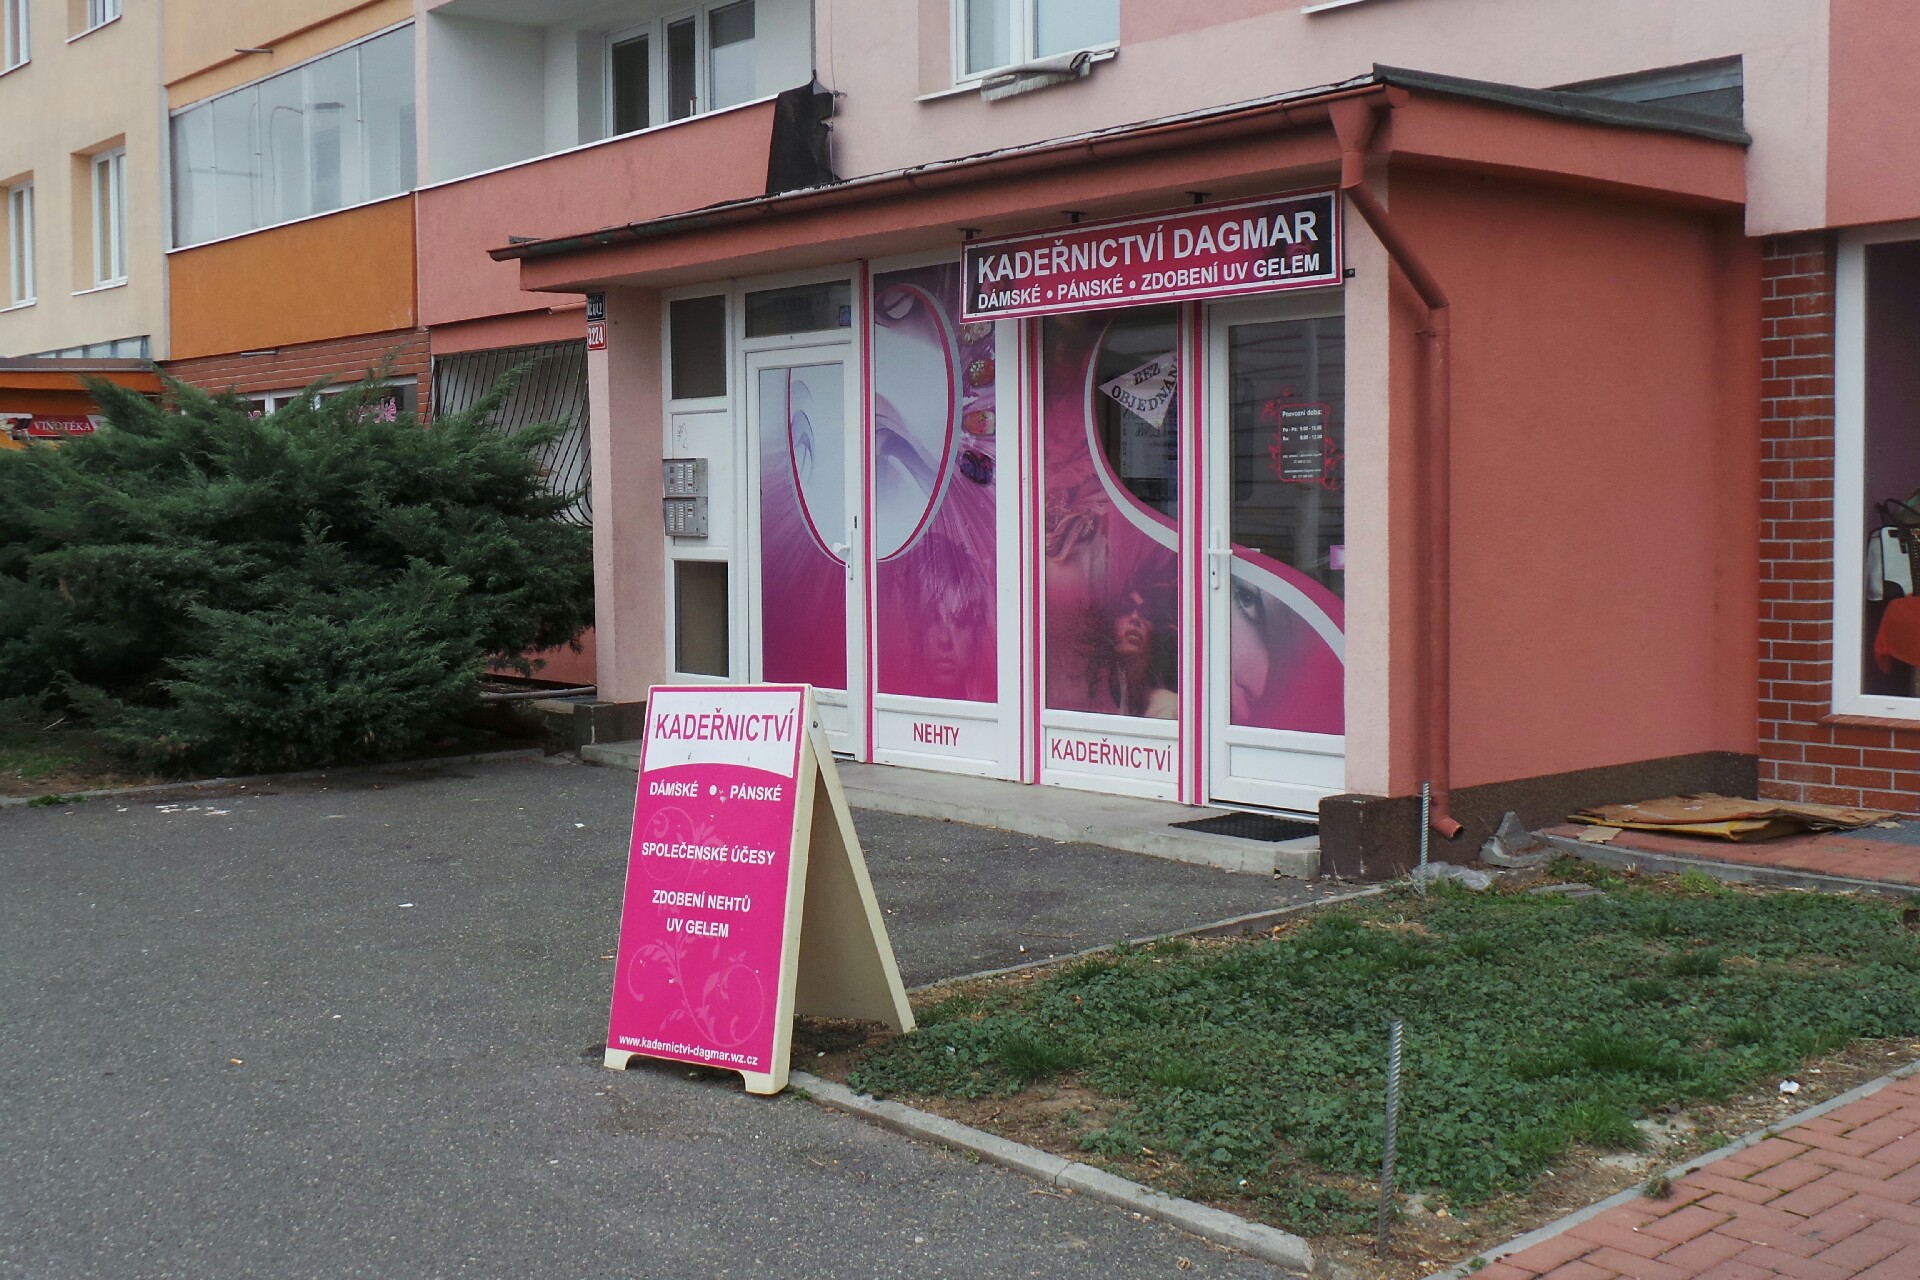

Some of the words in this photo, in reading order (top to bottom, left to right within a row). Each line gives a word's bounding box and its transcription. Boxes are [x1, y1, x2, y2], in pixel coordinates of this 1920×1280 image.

[977, 224, 1165, 284] KADEŘNICTVÍ
[1173, 210, 1319, 260] DAGMAR
[977, 284, 1041, 309] DÁMSKÉ
[1057, 277, 1124, 300] PÁNSKÉ
[1140, 265, 1219, 291] ZDOBENÍ
[1223, 261, 1249, 281] UV
[1253, 252, 1320, 277] GELEM
[1133, 362, 1161, 386] BEZ
[33, 420, 92, 431] VINOTÉKA
[655, 708, 795, 742] KADEŘNICTVÍ
[913, 722, 960, 746] NEHTY
[1051, 737, 1172, 772] KADEŘNICTVÍ
[649, 779, 699, 797] DÁMSKÉ
[729, 782, 782, 801] PÁNSKÉ
[641, 841, 729, 862] SPOLEČENSKÉ
[730, 845, 776, 865] ÚČESY
[652, 889, 706, 908] ZDOBENÍ
[707, 894, 751, 912] NEHTŮ
[666, 917, 684, 932] UV
[685, 919, 729, 938] GELEM
[619, 1034, 759, 1066] www.kadernictvi-dagmar.wz.cz
